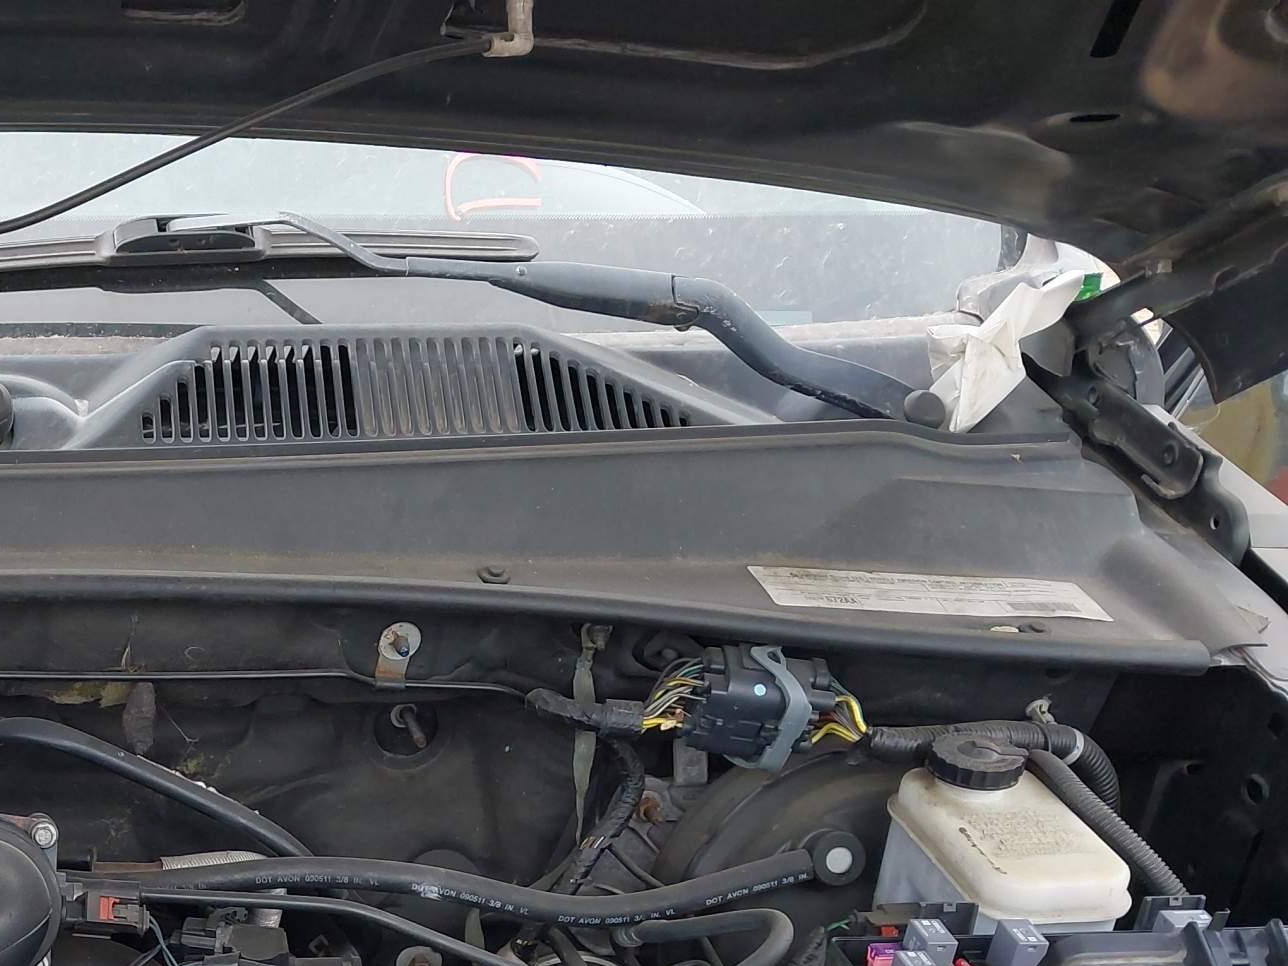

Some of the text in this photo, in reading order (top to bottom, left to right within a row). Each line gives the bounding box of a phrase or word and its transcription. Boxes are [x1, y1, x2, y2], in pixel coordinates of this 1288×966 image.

[277, 874, 300, 884] AVON
[705, 894, 723, 907] DOT
[726, 887, 749, 900] AVON
[782, 875, 795, 885] 3/8
[558, 915, 576, 923] DOT
[578, 917, 601, 925] AVON
